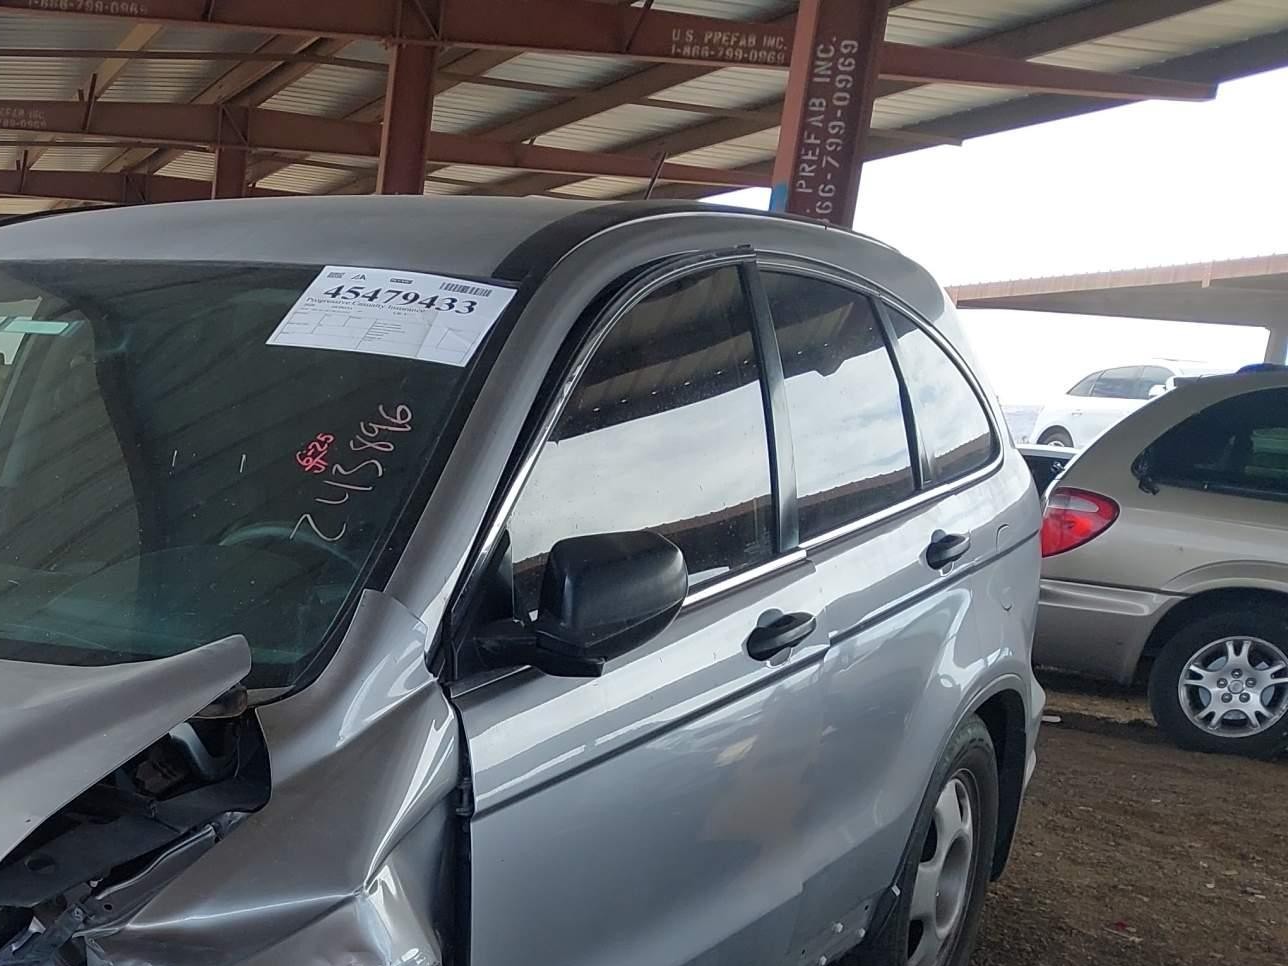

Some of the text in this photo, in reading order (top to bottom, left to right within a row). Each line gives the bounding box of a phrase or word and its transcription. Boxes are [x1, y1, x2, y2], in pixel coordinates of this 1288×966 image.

[763, 34, 788, 51] INC.
[795, 35, 837, 193] PREFAB INC.
[323, 284, 478, 315] 45479433
